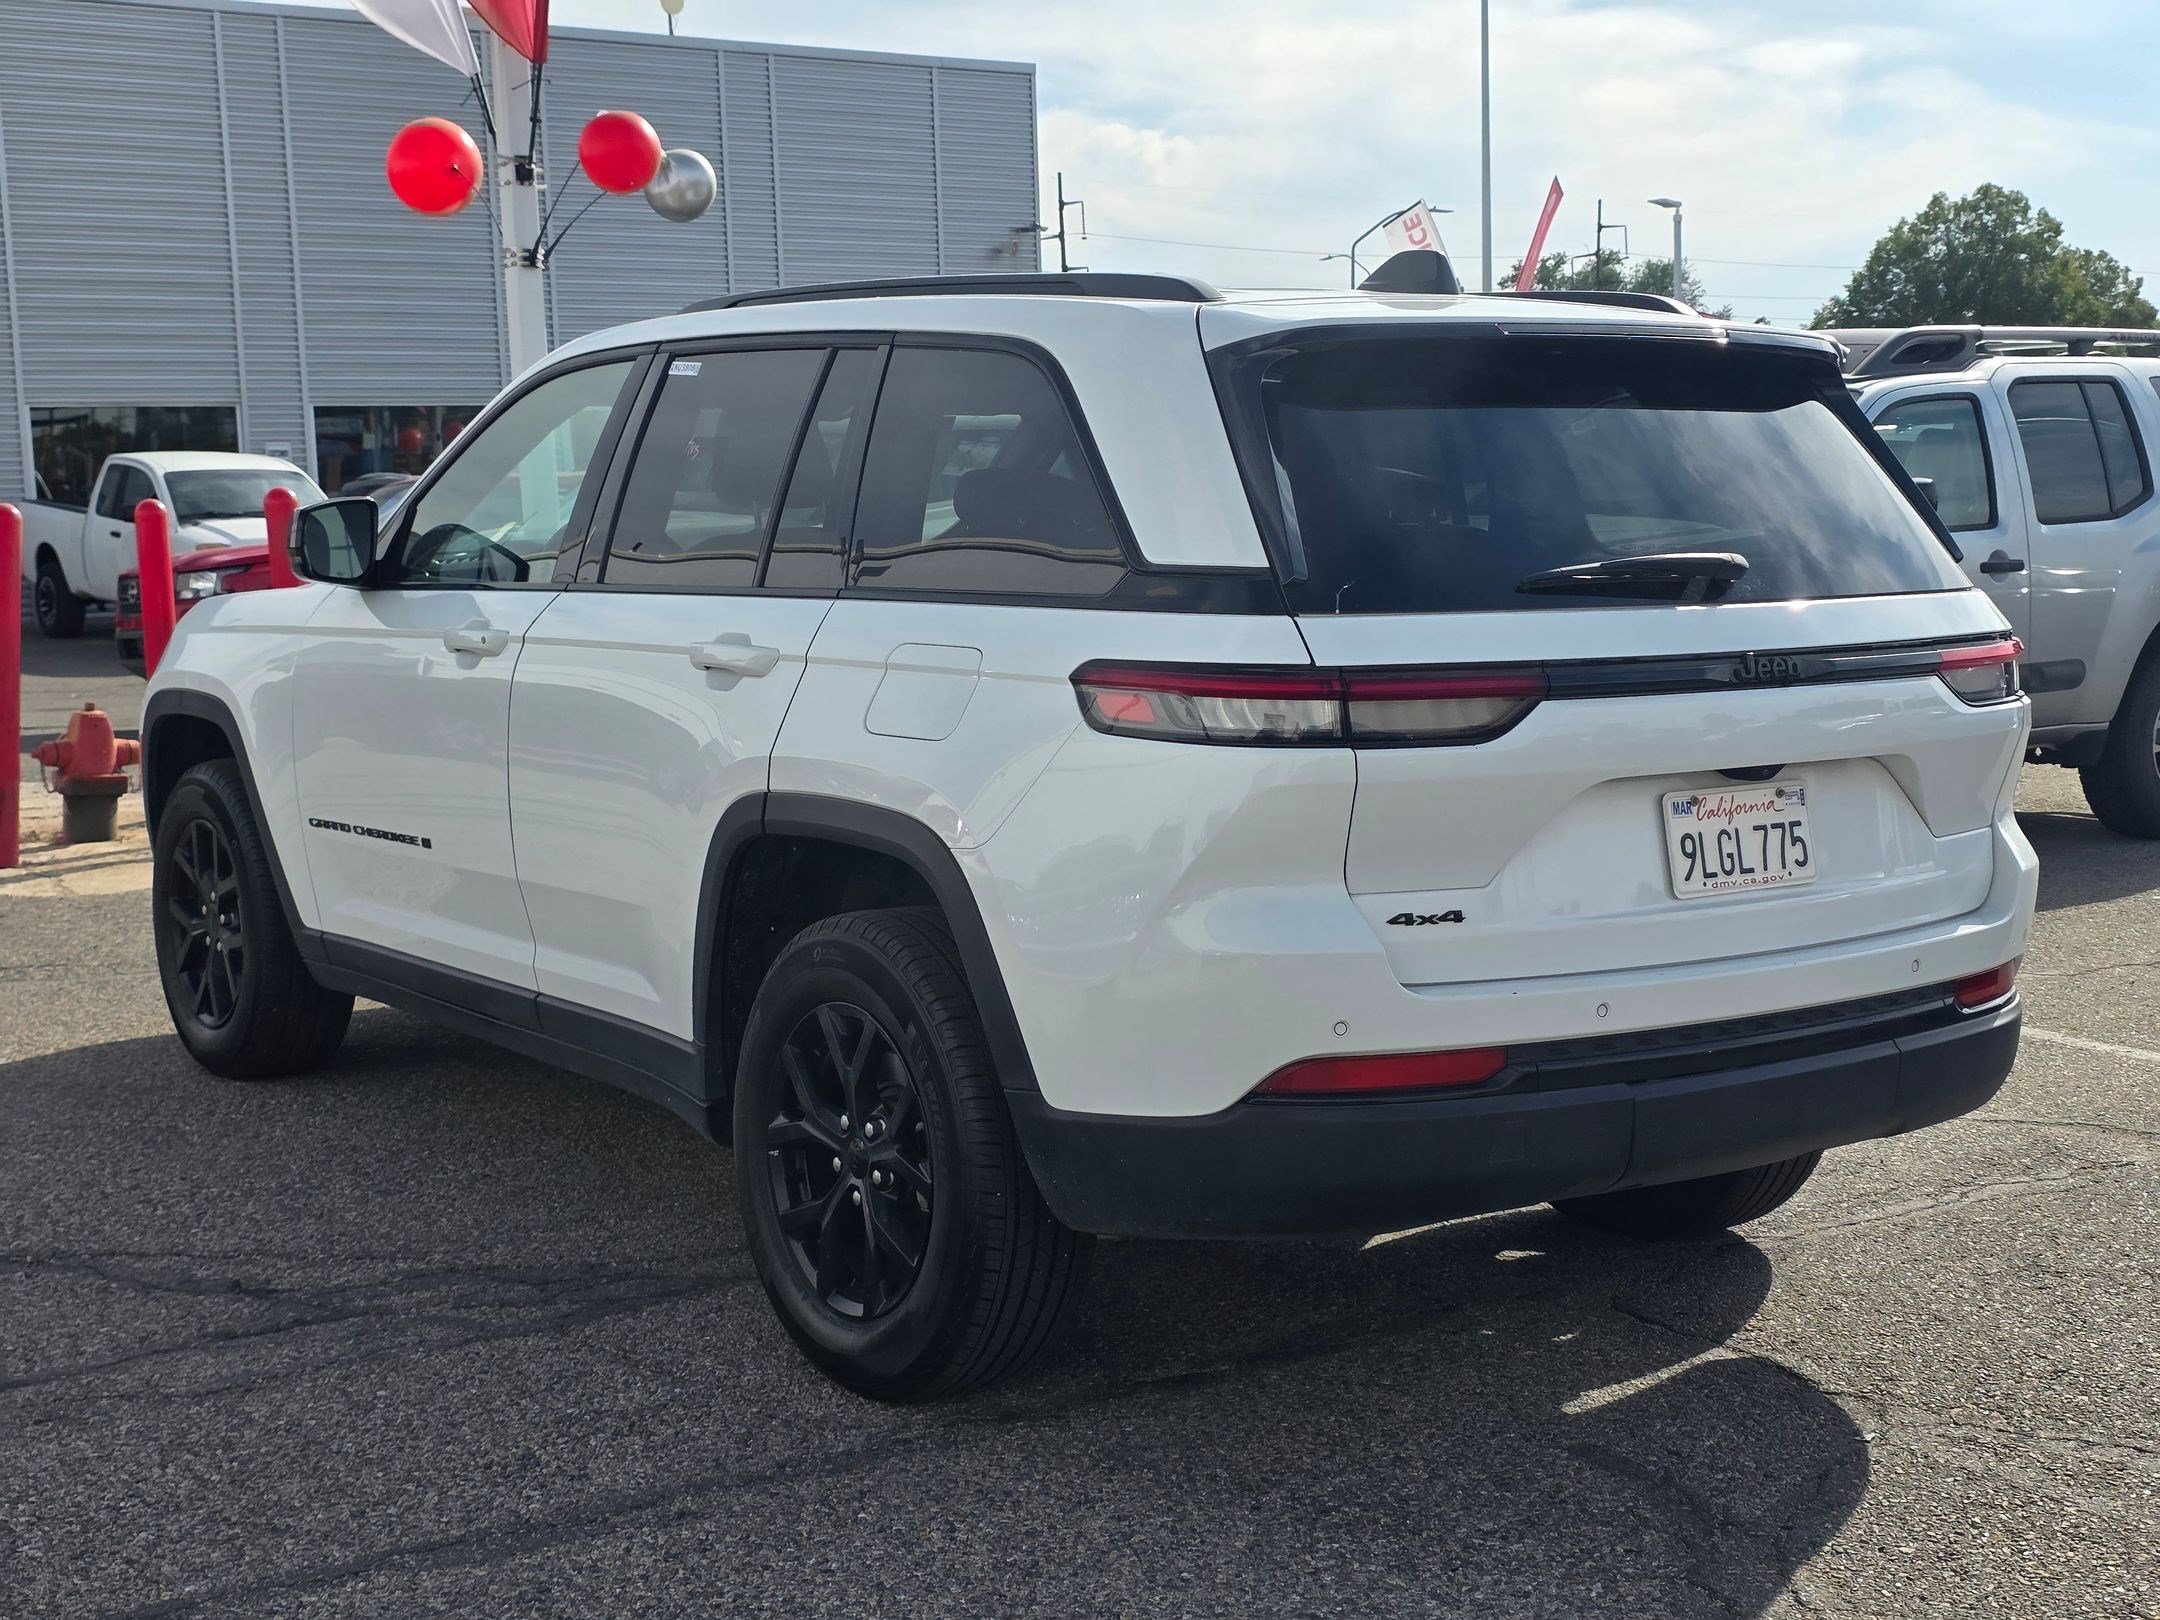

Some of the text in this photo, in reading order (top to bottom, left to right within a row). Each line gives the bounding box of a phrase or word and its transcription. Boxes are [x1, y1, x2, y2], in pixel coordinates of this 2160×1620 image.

[1729, 653, 1800, 683] Jeep
[1672, 801, 1693, 816] MAR
[1696, 795, 1784, 825] California
[308, 817, 420, 847] GRAND CHEROKEE
[1680, 820, 1809, 882] 9LGL775
[1711, 873, 1785, 889] dmv.ca.gov
